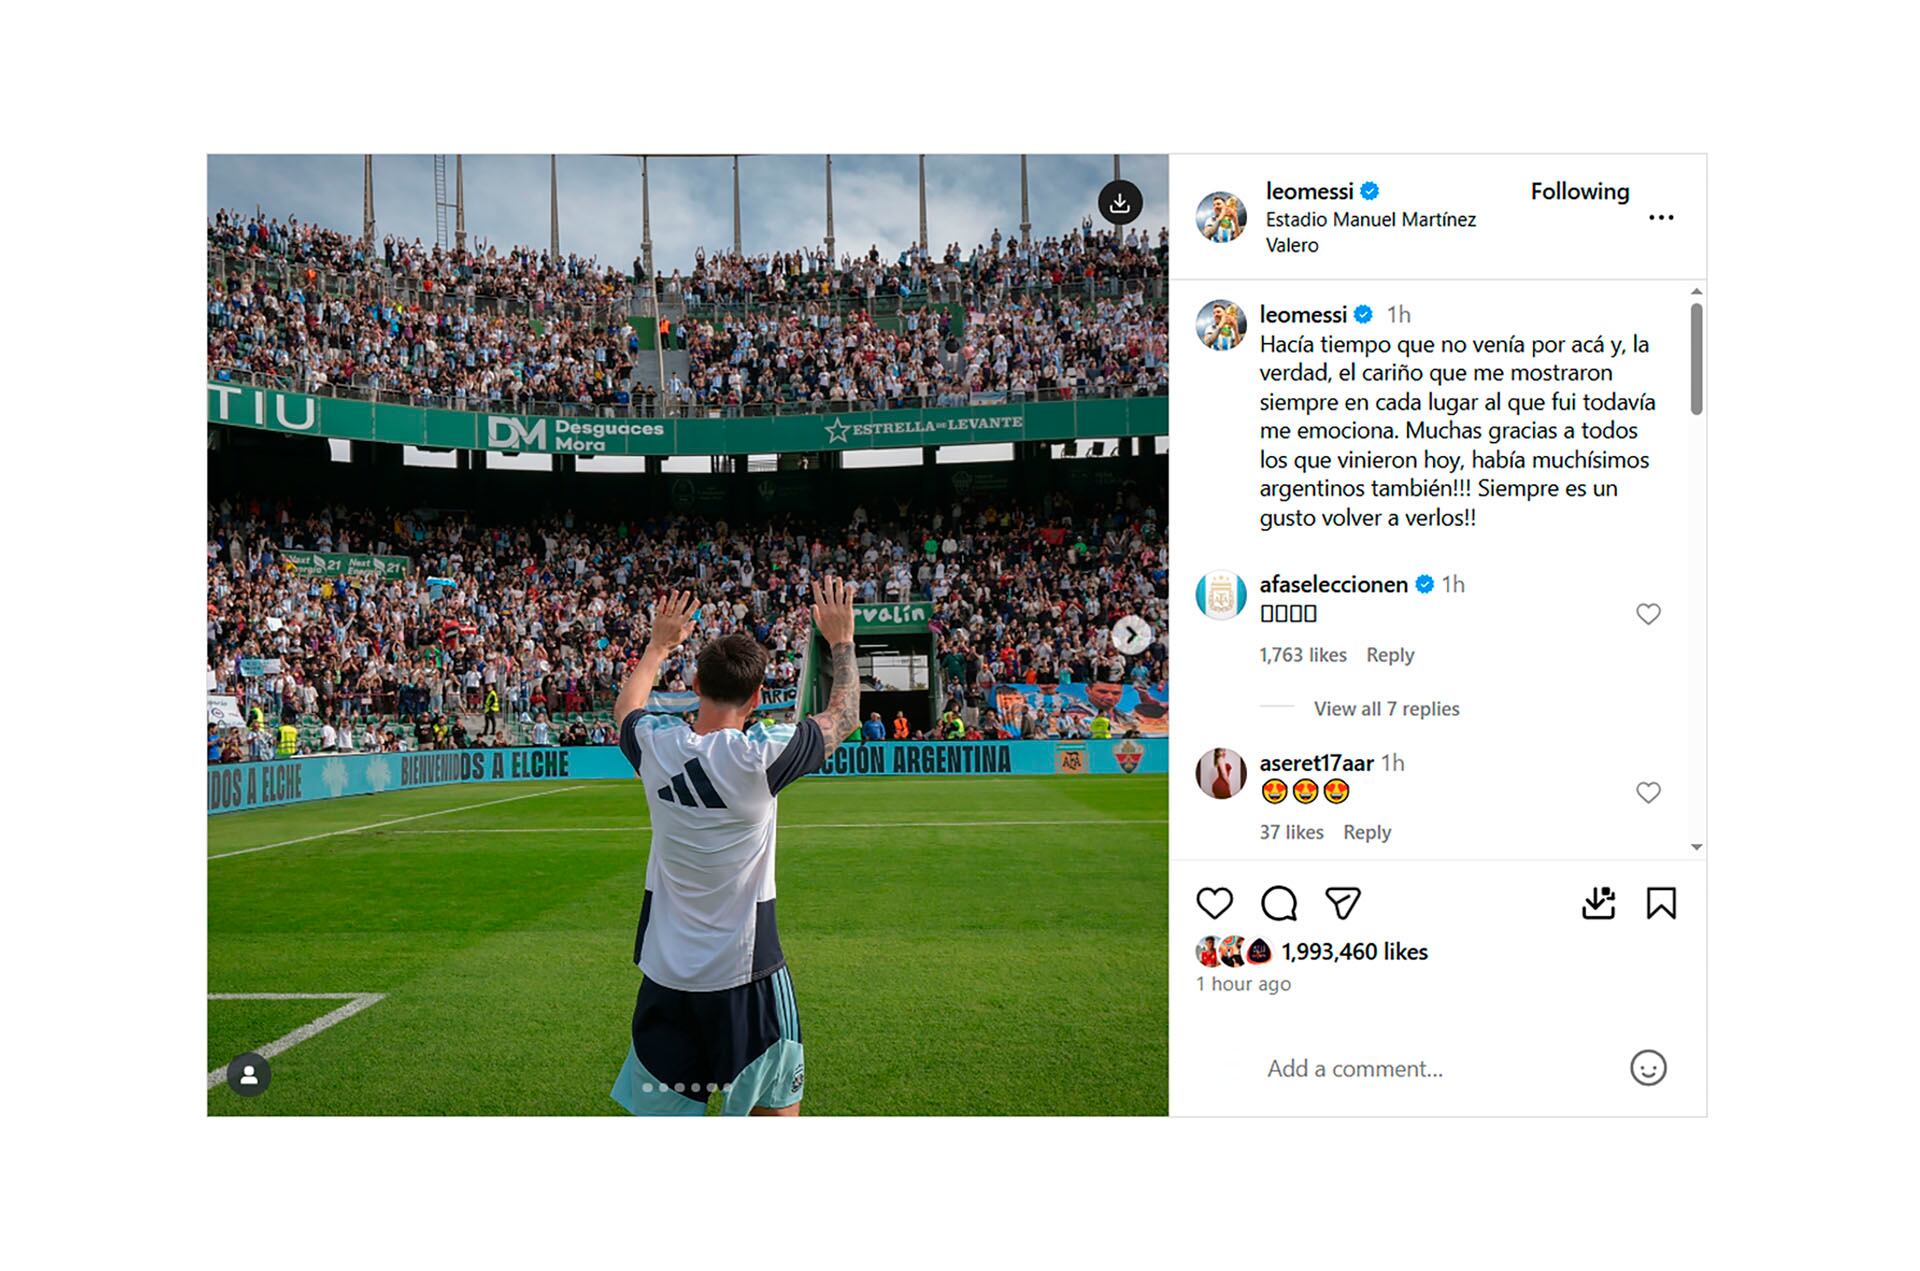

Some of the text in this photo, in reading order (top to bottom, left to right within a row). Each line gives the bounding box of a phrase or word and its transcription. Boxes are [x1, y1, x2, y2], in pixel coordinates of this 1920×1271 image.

[1266, 180, 1355, 201] leomessi
[1531, 180, 1630, 206] Following
[1266, 211, 1477, 228] Estadio Manuel Martínez
[1265, 236, 1320, 254] Valero
[1260, 303, 1348, 324] leomessi
[1387, 303, 1411, 324] 1h
[1260, 333, 1650, 358] Hacía tiempo que no venía por acá y, la
[1259, 361, 1613, 387] verdad, el cariño que me mostraron
[1260, 390, 1656, 416] siempre en cada lugar al que fui todavía
[488, 415, 547, 450] DM
[555, 419, 665, 438] Desguaces
[853, 419, 936, 436] ESTRELLA
[947, 416, 1024, 431] LEVANTE
[1260, 419, 1639, 445] me emociona. Muchas gracias a todos
[555, 437, 606, 451] Mora
[1260, 448, 1650, 474] los que vinieron hoy, había muchísimos
[1259, 477, 1618, 502] argentinos también!!! Siempre es un
[1259, 506, 1476, 532] gusto volver a verlos!!
[327, 560, 342, 571] 21
[349, 558, 372, 567] Next
[387, 563, 402, 574] 21
[1259, 573, 1409, 594] afaseleccionen
[1442, 573, 1465, 594] 1h
[1259, 646, 1348, 665] 1,763 likes
[1367, 646, 1416, 667] Reply
[1313, 700, 1461, 721] View all 7 replies
[401, 751, 569, 786] BIENVENIDOS A ELCHE
[893, 745, 1012, 774] ARGENTINA
[1259, 753, 1376, 772] aseret17aar
[1381, 752, 1405, 772] 1h
[247, 767, 257, 805] A
[262, 763, 303, 802] ELCHE
[1260, 823, 1325, 841] 37 likes
[1344, 823, 1393, 844] Reply
[1281, 941, 1378, 964] 1,993,460
[1384, 940, 1429, 961] likes
[1196, 975, 1292, 996] 1 hour ago
[1267, 1057, 1444, 1078] Add a comment...
